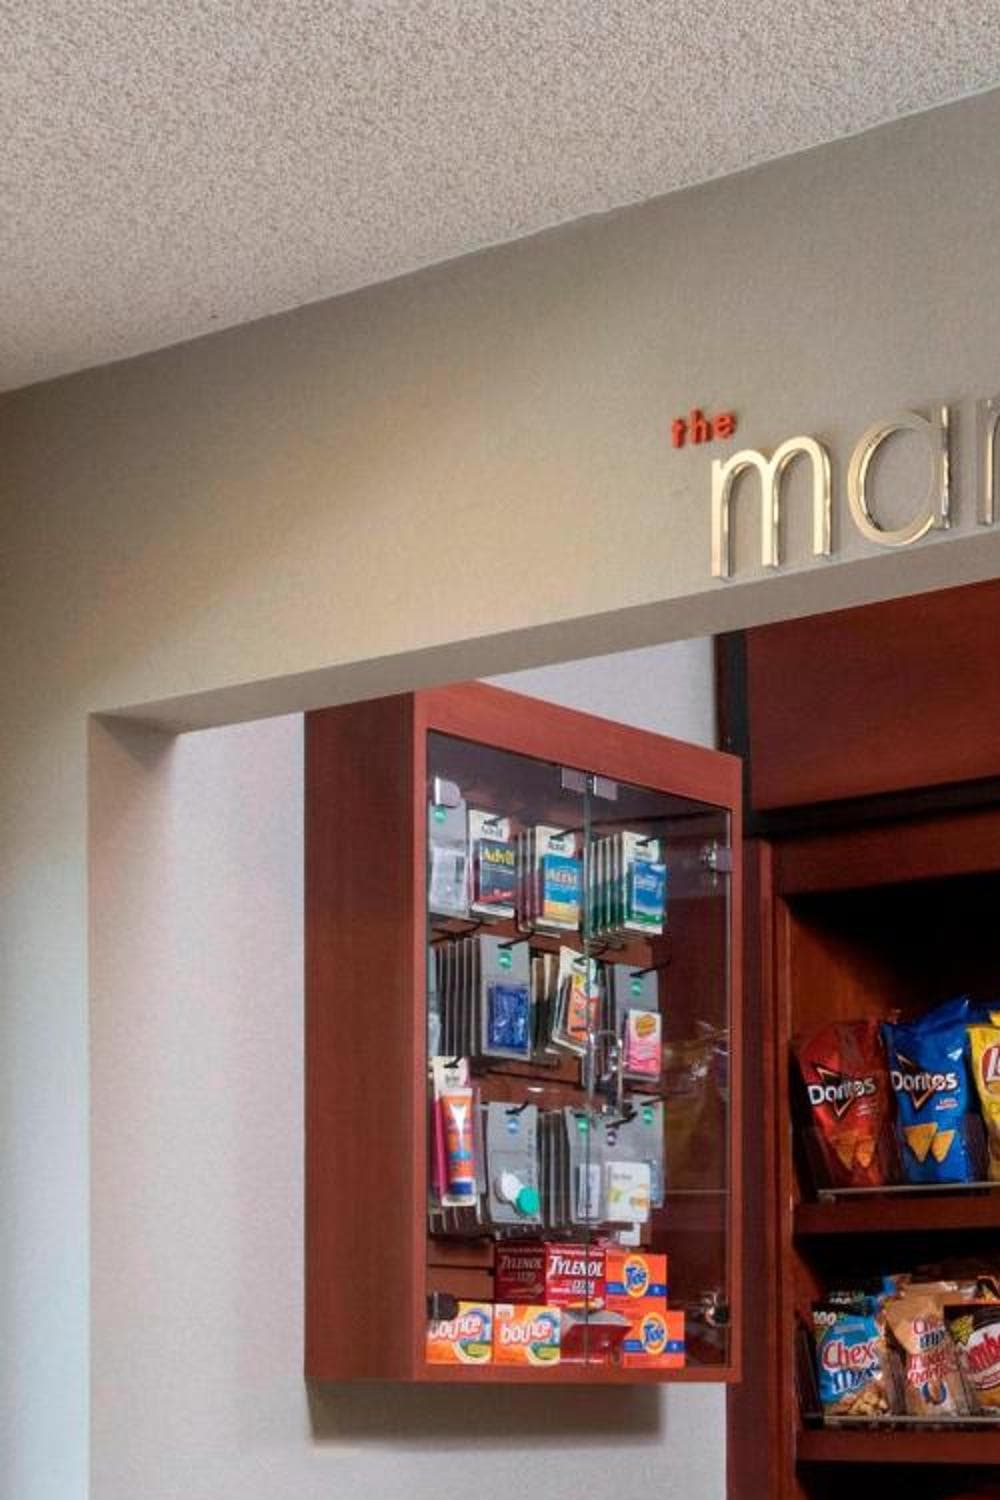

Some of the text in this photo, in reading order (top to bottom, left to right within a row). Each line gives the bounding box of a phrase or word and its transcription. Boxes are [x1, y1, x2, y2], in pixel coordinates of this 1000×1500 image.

[671, 410, 735, 448] the
[808, 1077, 876, 1105] Doritos
[890, 1070, 958, 1092] Doritos
[549, 1255, 604, 1277] TYLENOL
[823, 1340, 878, 1369] Chex
